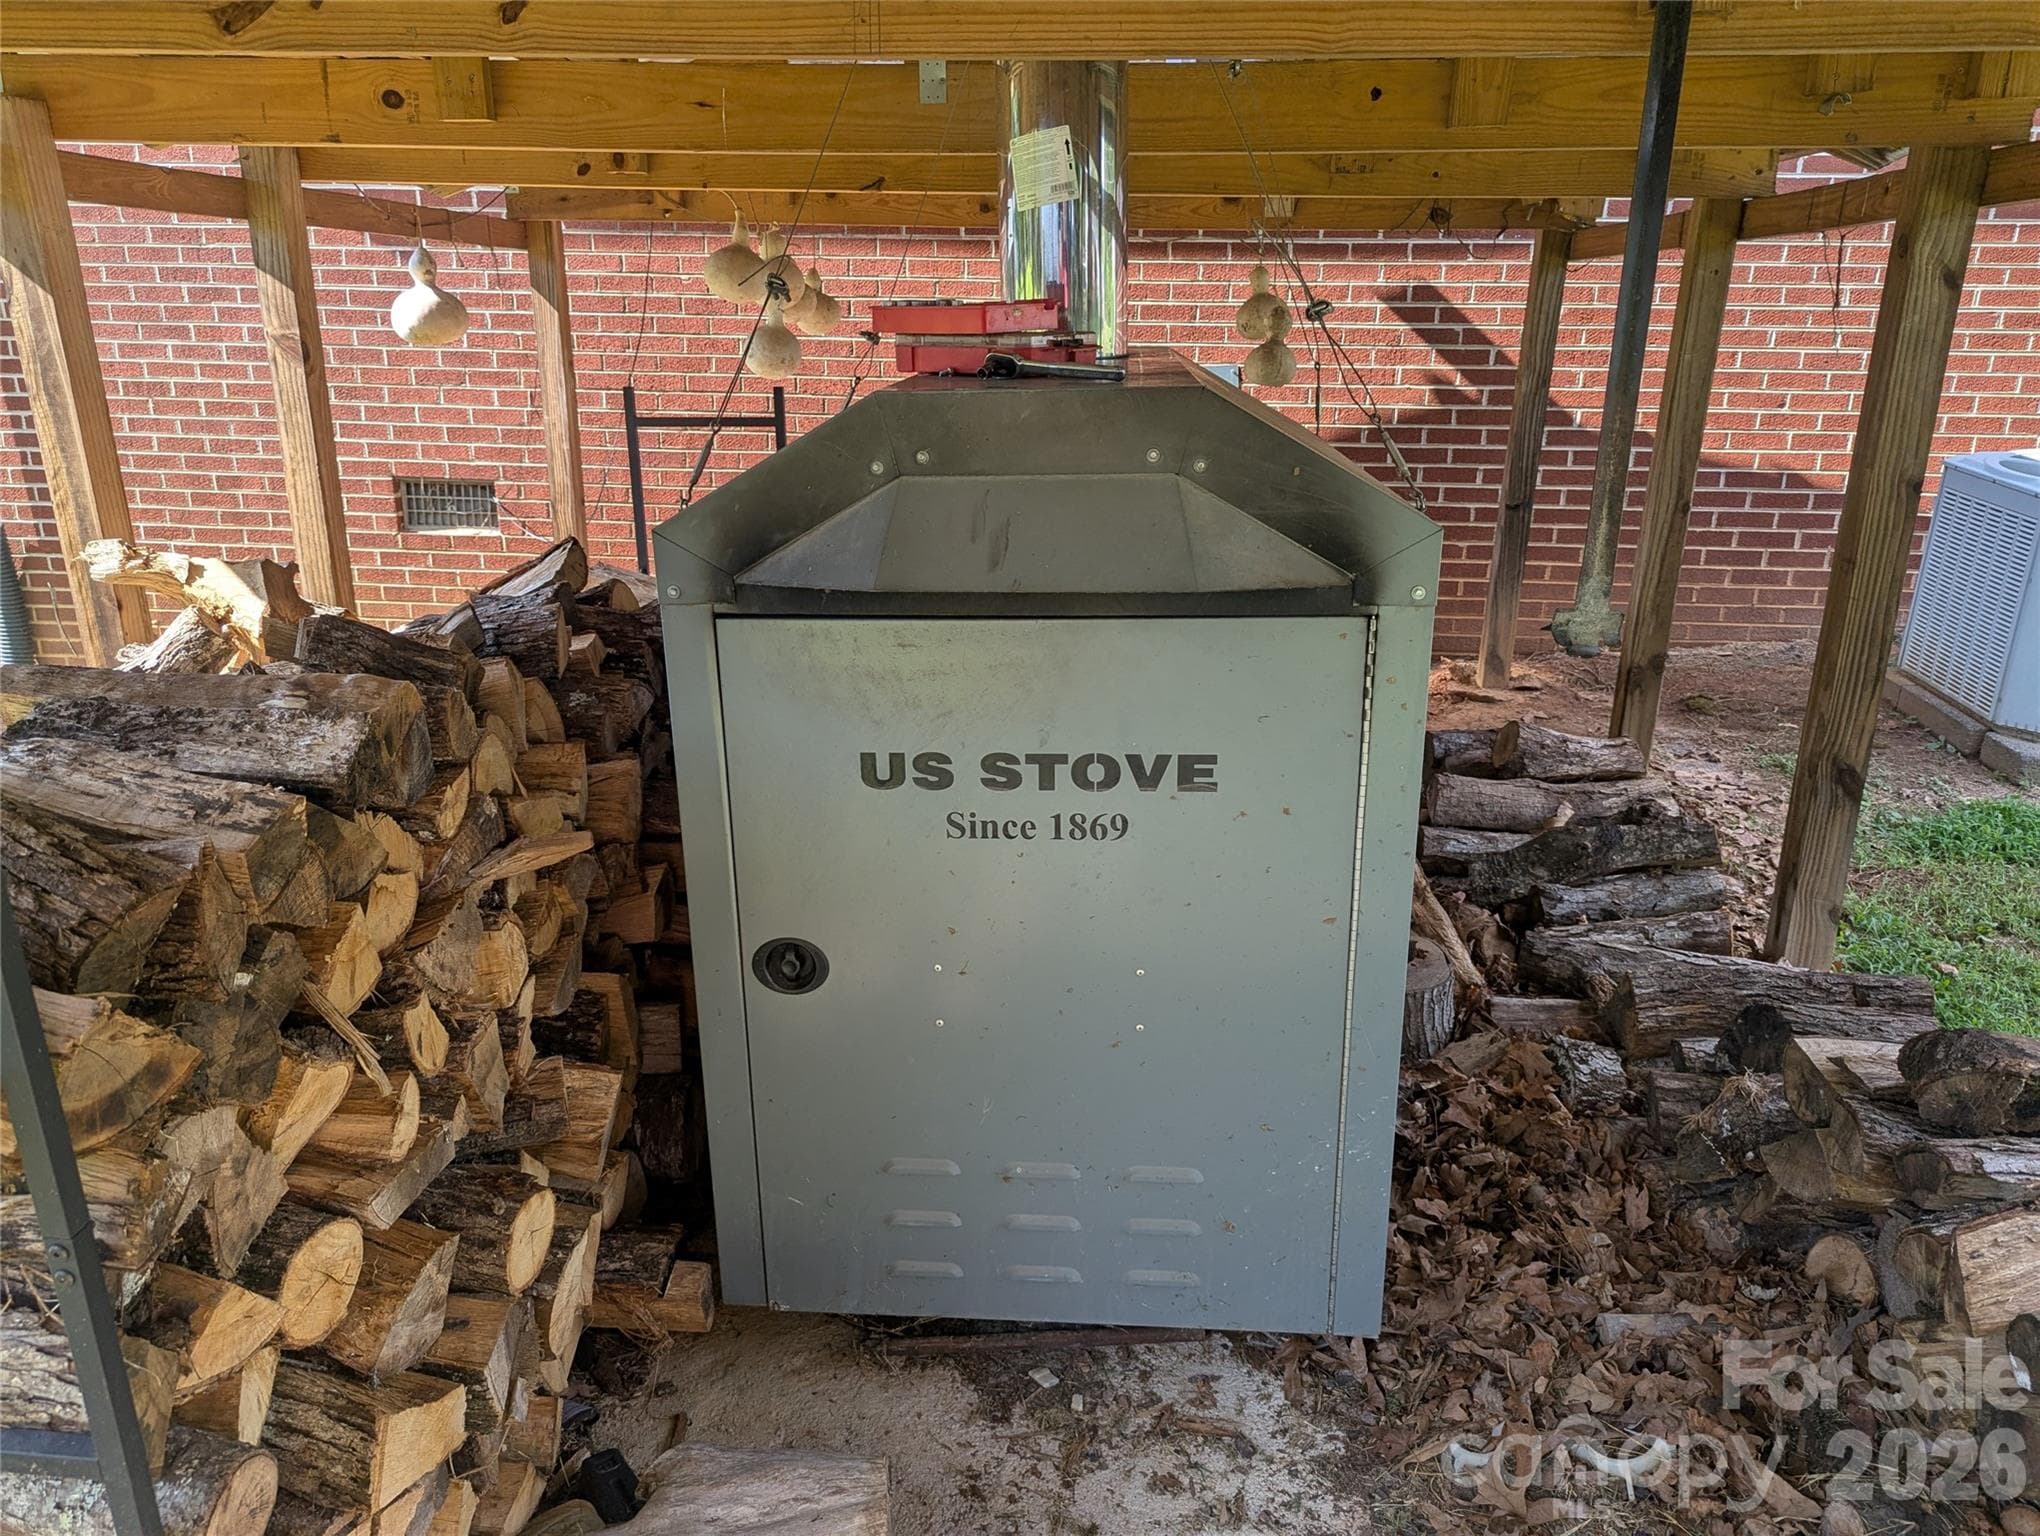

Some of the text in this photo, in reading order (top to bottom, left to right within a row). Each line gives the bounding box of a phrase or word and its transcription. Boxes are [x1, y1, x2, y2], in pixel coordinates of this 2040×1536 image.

[860, 752, 1218, 793] US STOVE
[946, 811, 1129, 841] Since 1869
